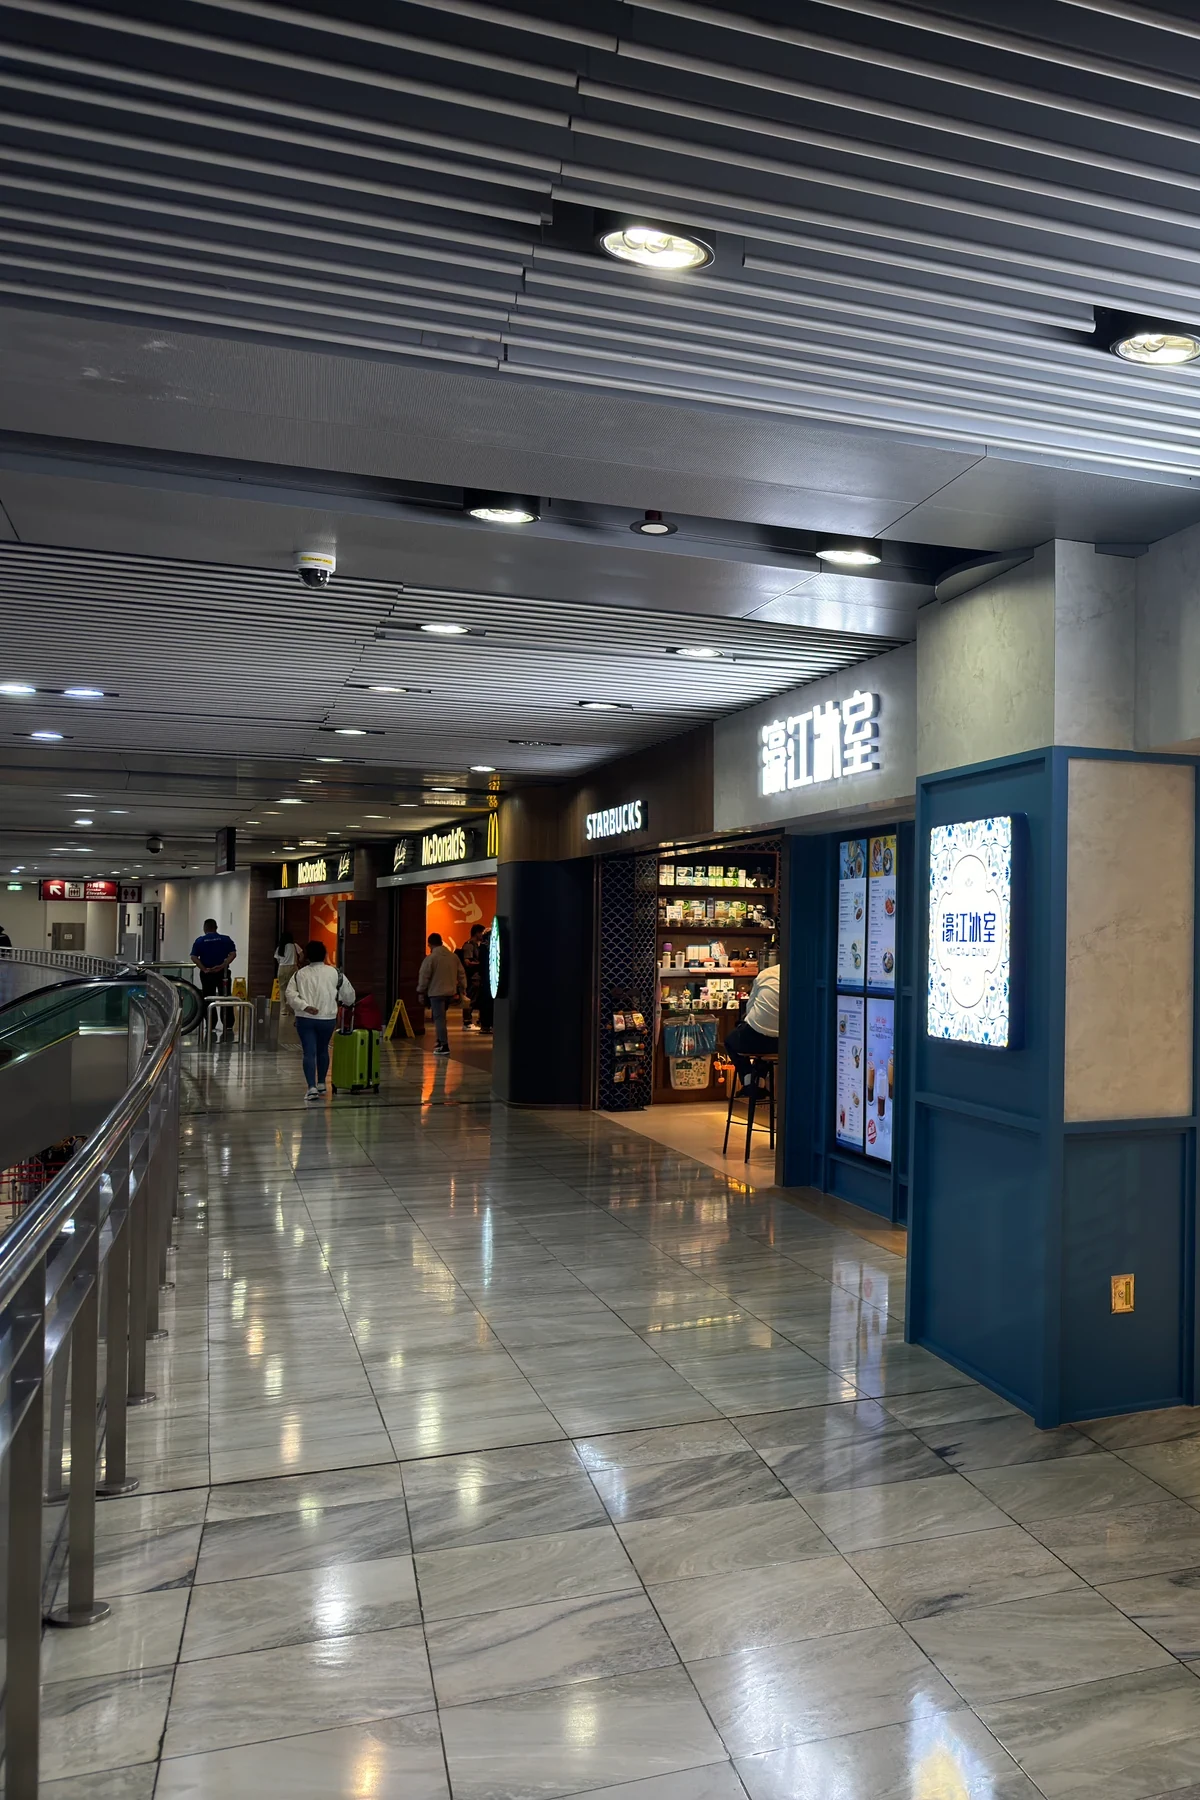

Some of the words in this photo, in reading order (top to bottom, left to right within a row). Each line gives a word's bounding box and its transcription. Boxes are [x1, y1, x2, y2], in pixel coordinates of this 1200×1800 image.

[586, 799, 642, 841] STARBUCKS
[421, 826, 466, 866] McDonald's
[297, 858, 327, 884] McDonald's
[942, 911, 997, 943] 濠江冰室
